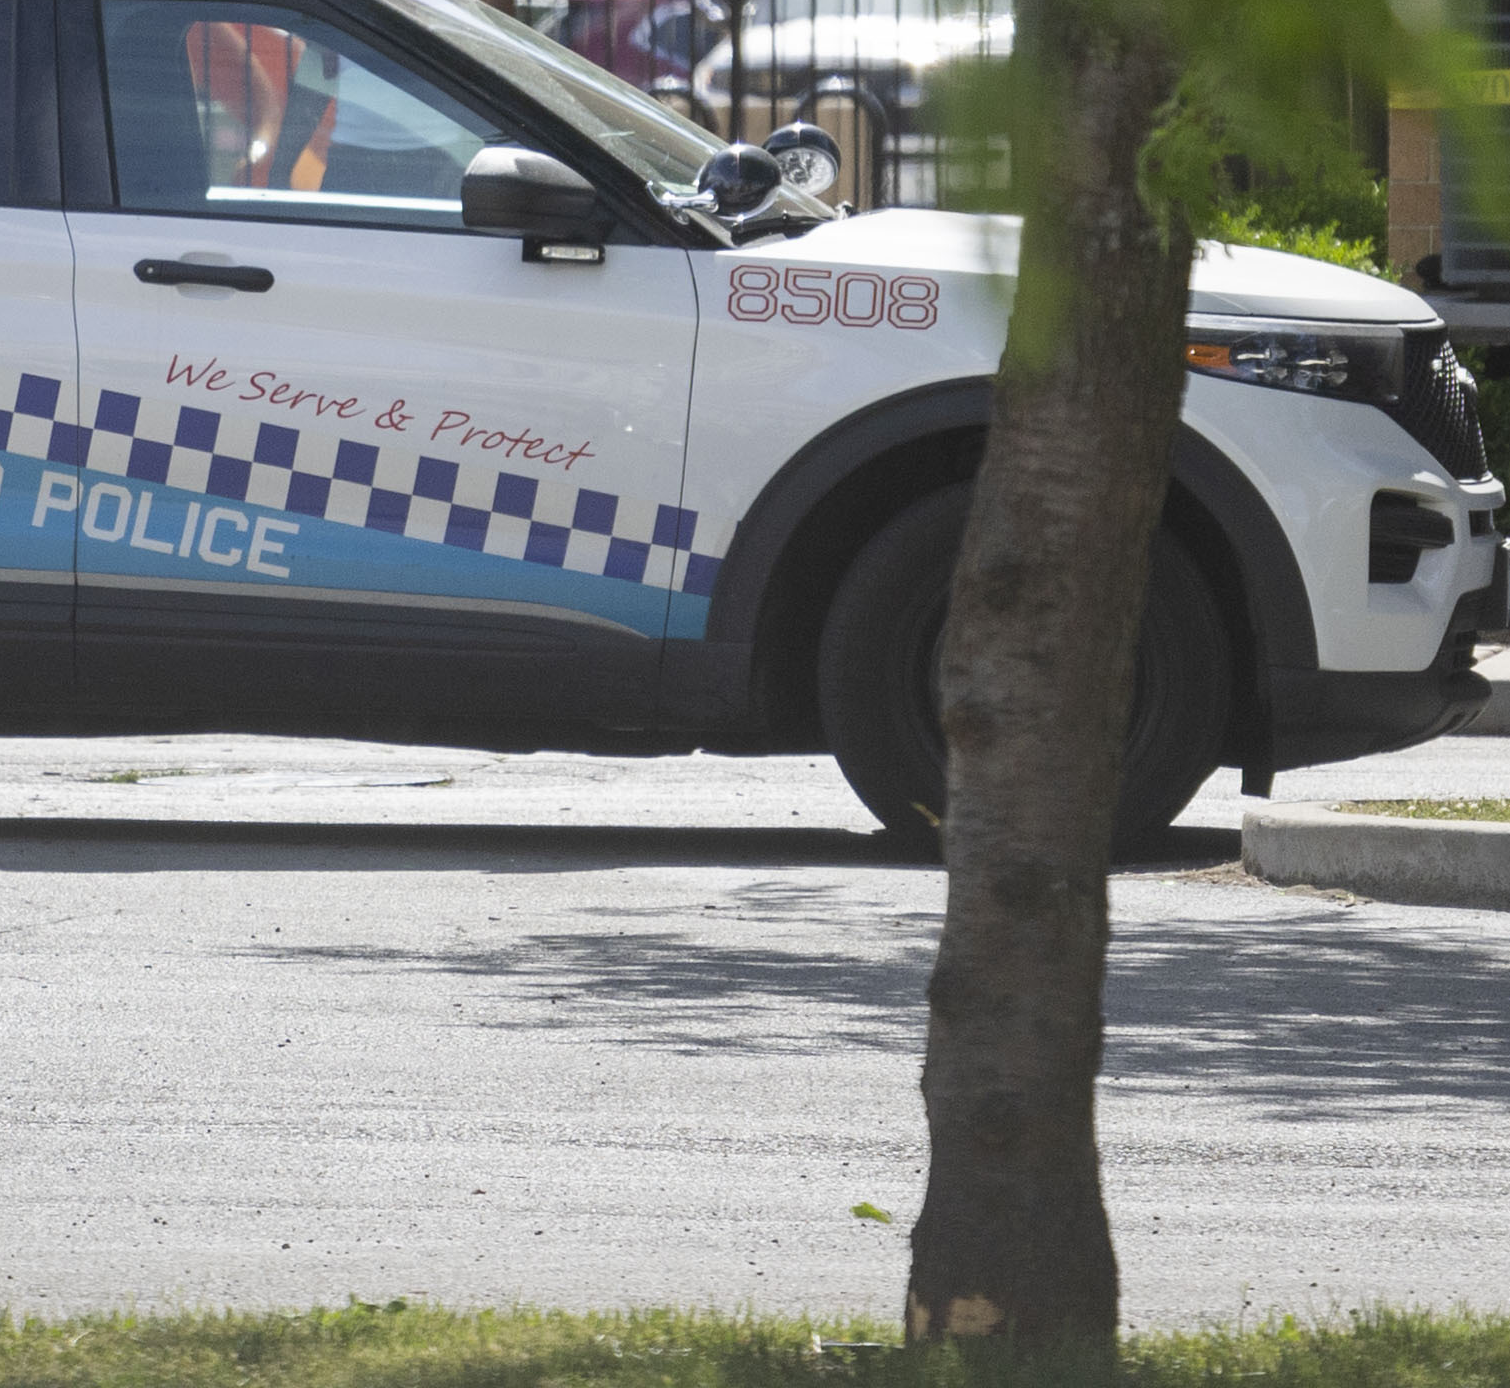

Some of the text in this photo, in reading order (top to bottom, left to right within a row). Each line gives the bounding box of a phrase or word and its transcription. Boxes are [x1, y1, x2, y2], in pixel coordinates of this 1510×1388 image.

[728, 265, 939, 330] 8508
[166, 353, 595, 471] We Serve & Protect
[31, 470, 300, 579] POLICE
